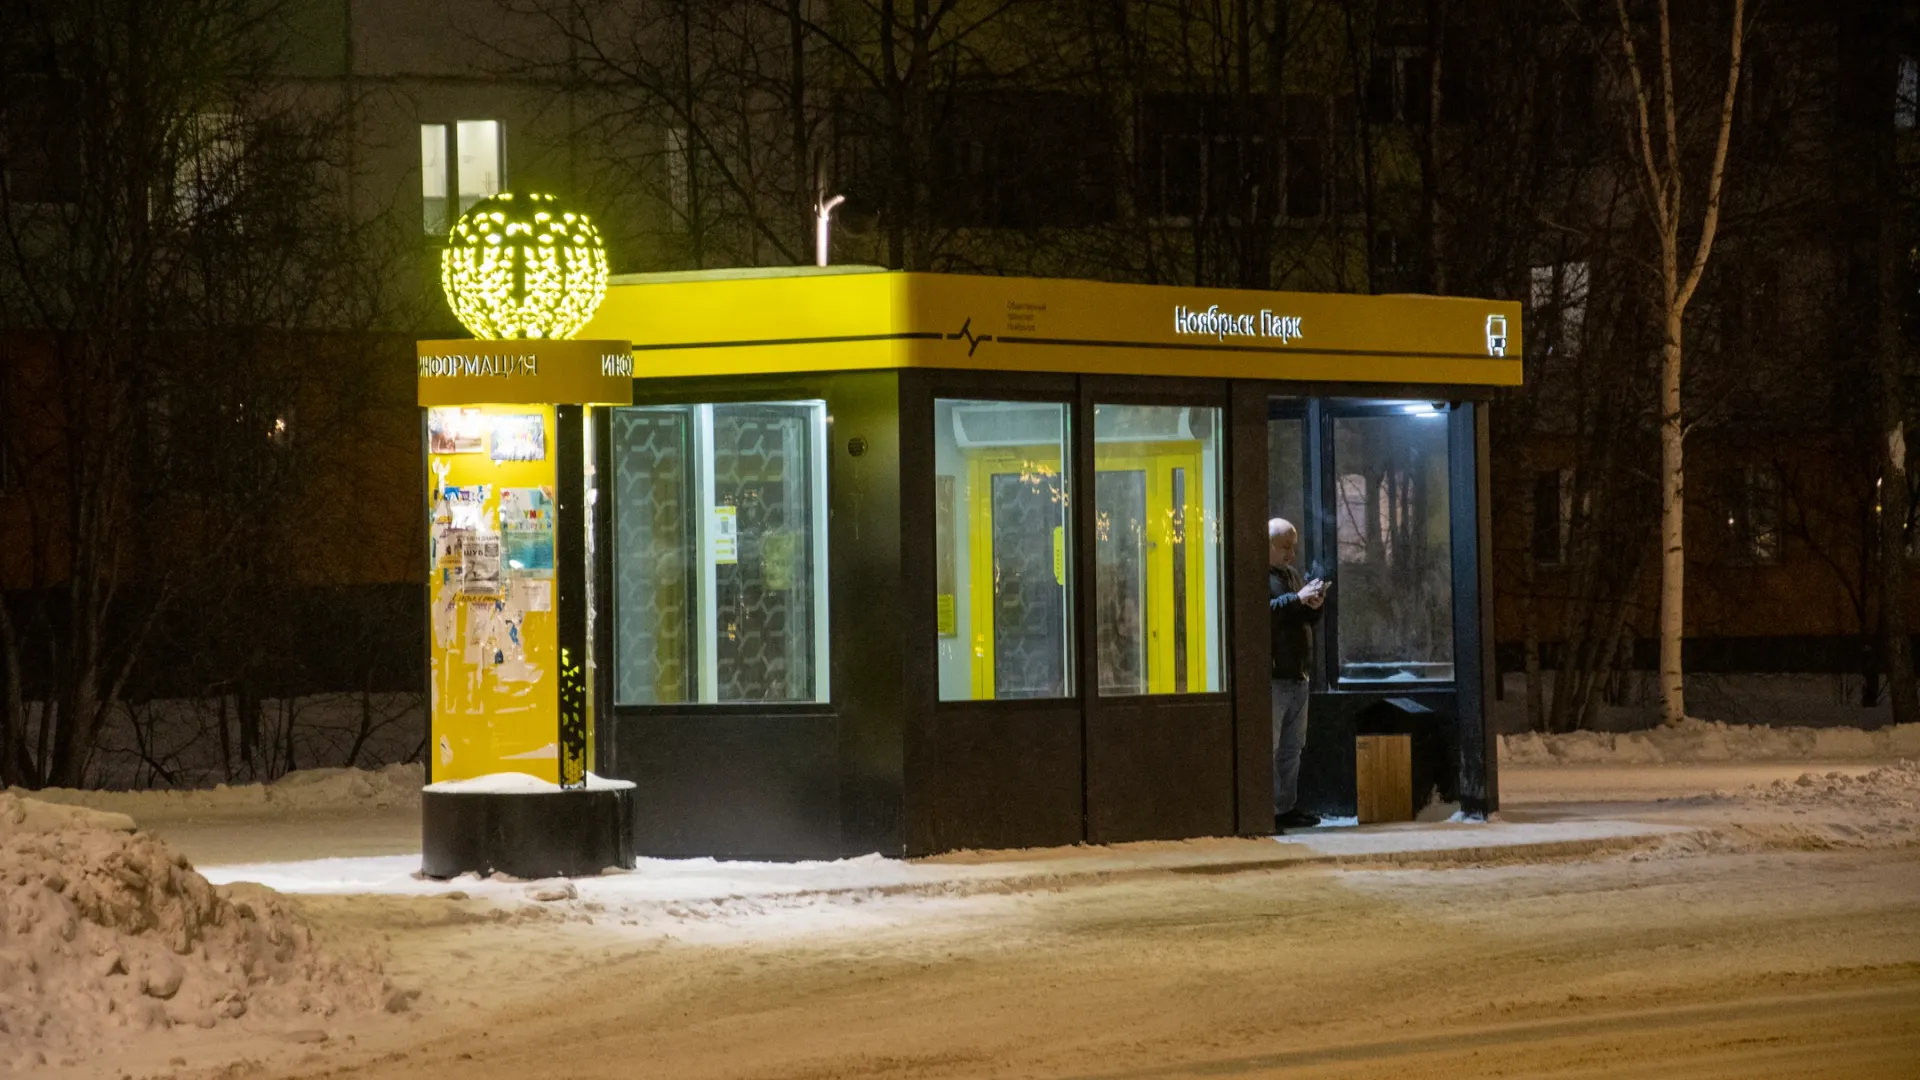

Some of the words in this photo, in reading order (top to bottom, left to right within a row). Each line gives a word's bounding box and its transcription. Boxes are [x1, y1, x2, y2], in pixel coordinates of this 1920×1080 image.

[1175, 305, 1256, 342] Ноябрьск
[1261, 309, 1303, 344] Парк
[419, 354, 538, 379] ИНФОРМАЦИЯ
